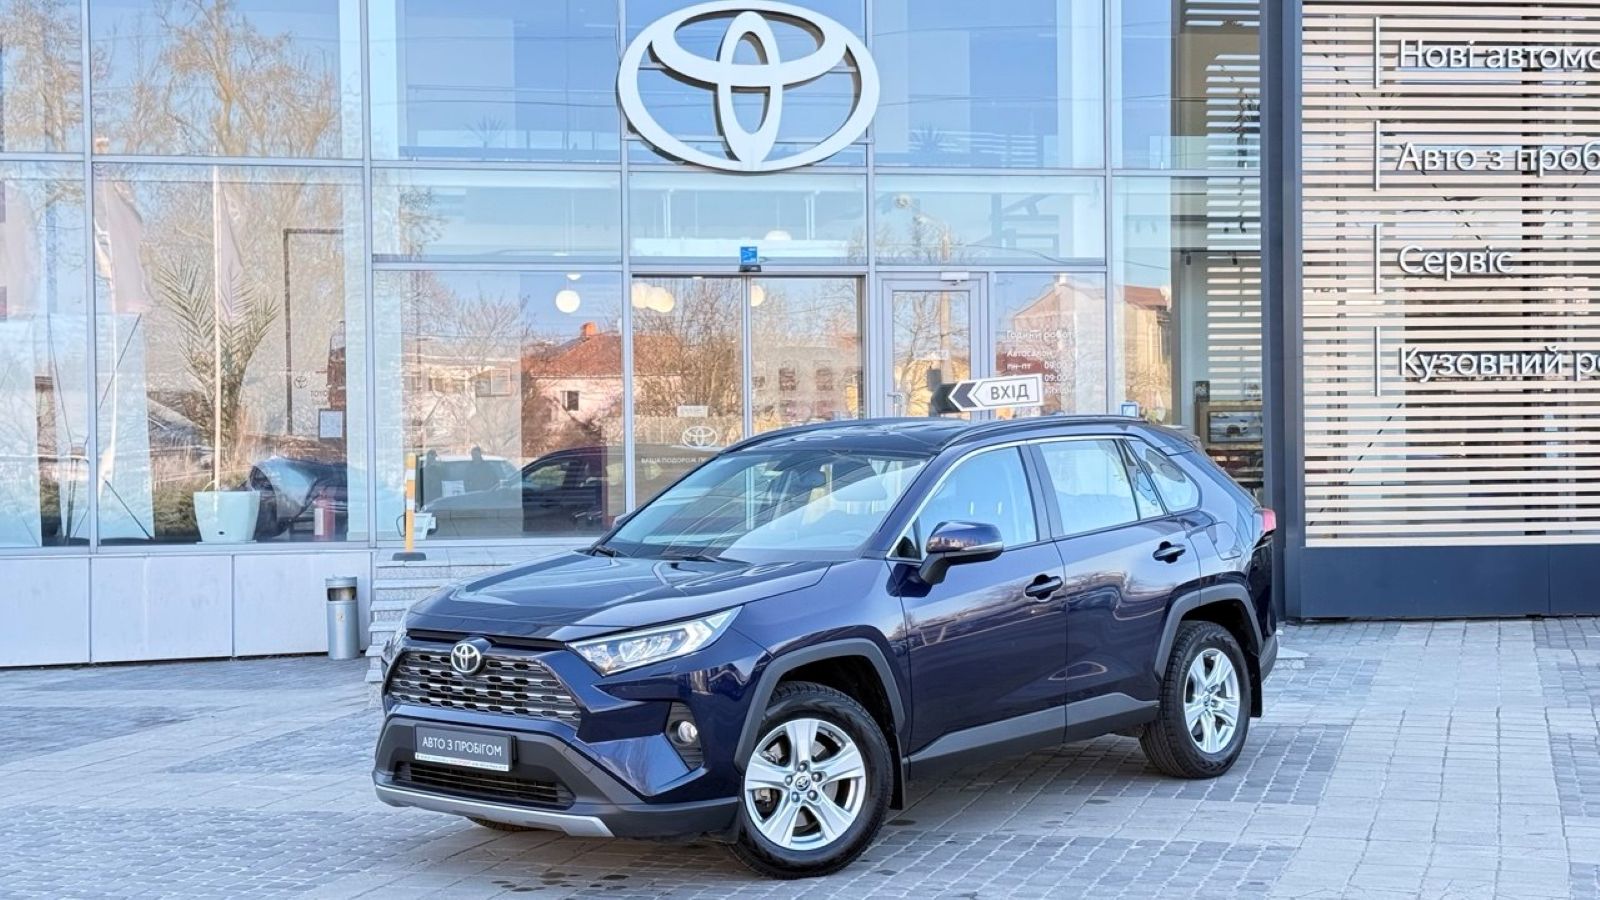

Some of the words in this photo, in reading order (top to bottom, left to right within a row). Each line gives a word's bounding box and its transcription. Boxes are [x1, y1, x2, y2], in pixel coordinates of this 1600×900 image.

[1400, 40, 1475, 68] Нові
[1397, 141, 1476, 170] Авто
[1486, 149, 1504, 170] з
[1518, 141, 1600, 177] проб
[1399, 246, 1514, 281] Сервіс
[1400, 345, 1563, 382] Кузовний
[1576, 352, 1600, 381] р
[990, 384, 1030, 401] ВХІД
[422, 736, 446, 750] АВТО
[455, 740, 502, 757] ПРОБІГОМ
